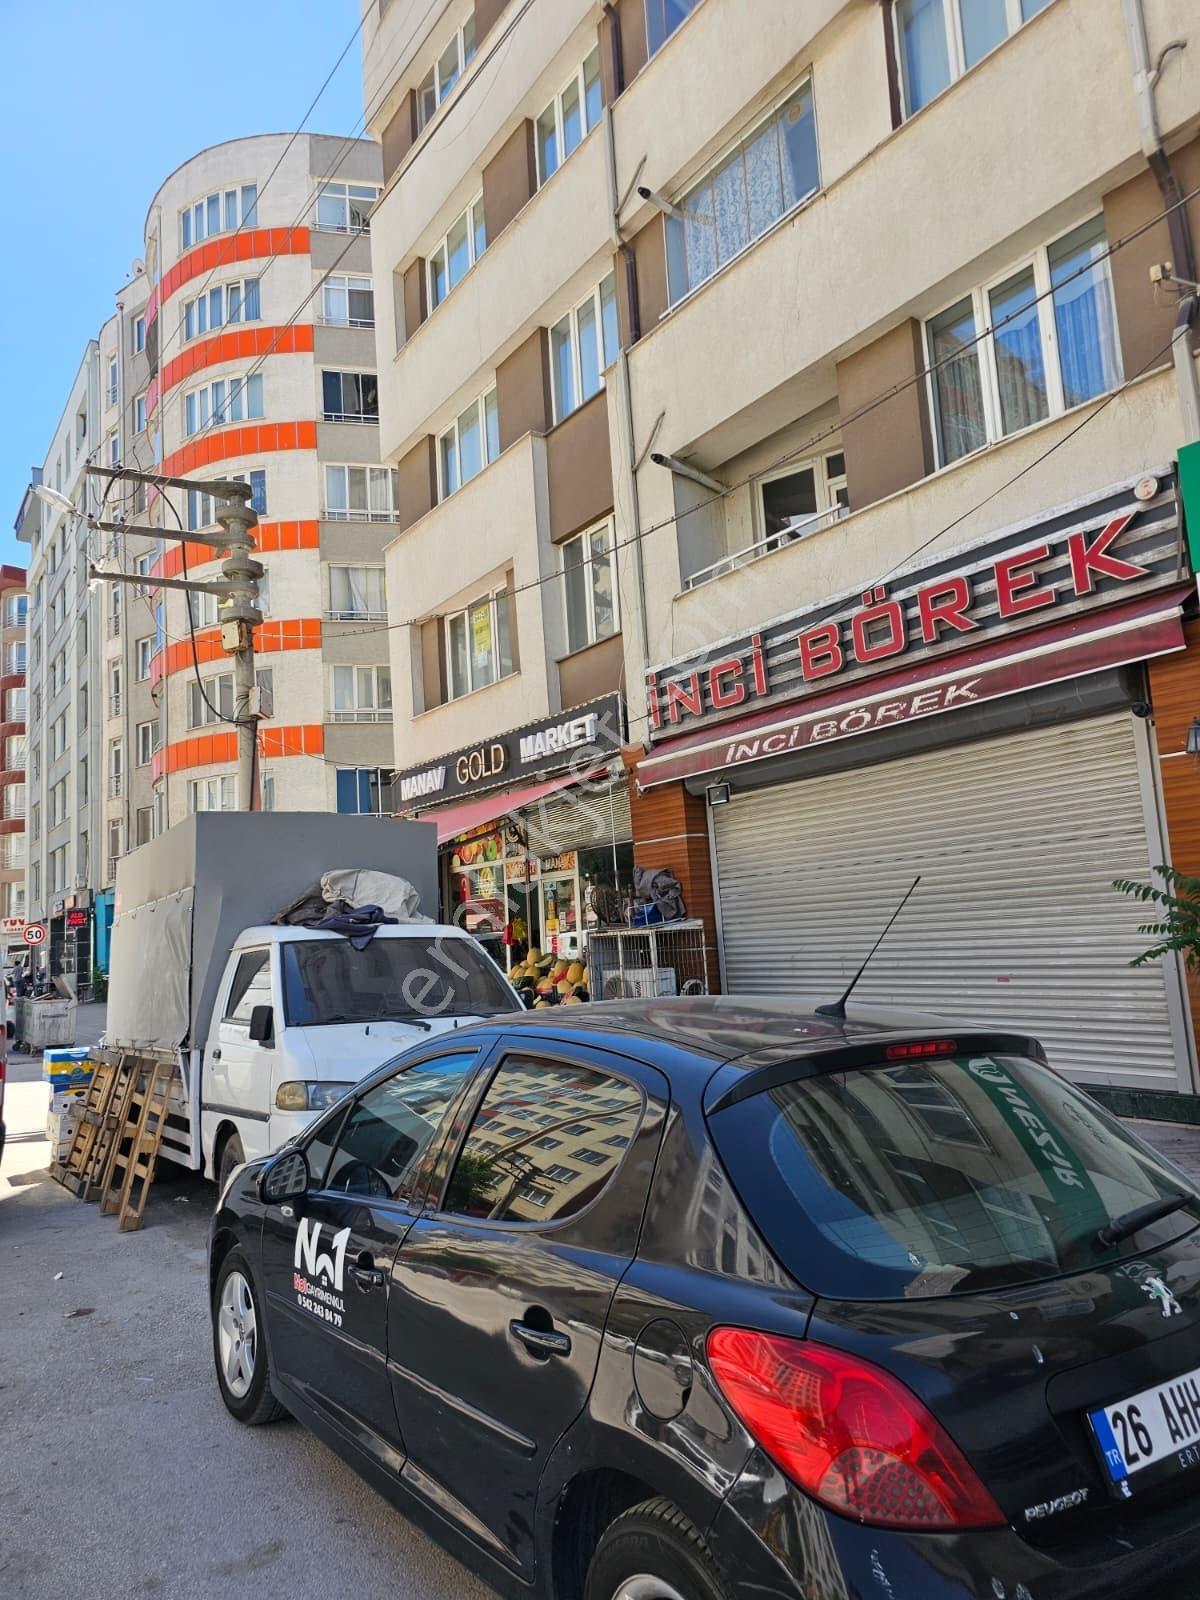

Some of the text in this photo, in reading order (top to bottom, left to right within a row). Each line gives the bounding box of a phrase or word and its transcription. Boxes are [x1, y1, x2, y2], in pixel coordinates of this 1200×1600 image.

[648, 512, 1152, 729] İNCİ BÖREK
[725, 678, 982, 764] İNCİ BÖREK
[401, 712, 598, 801] MANAV GOLD MARKET
[27, 930, 42, 940] 50
[1105, 1448, 1122, 1467] TR
[1111, 1404, 1153, 1467] 26
[1025, 1487, 1089, 1522] PEUGEOT
